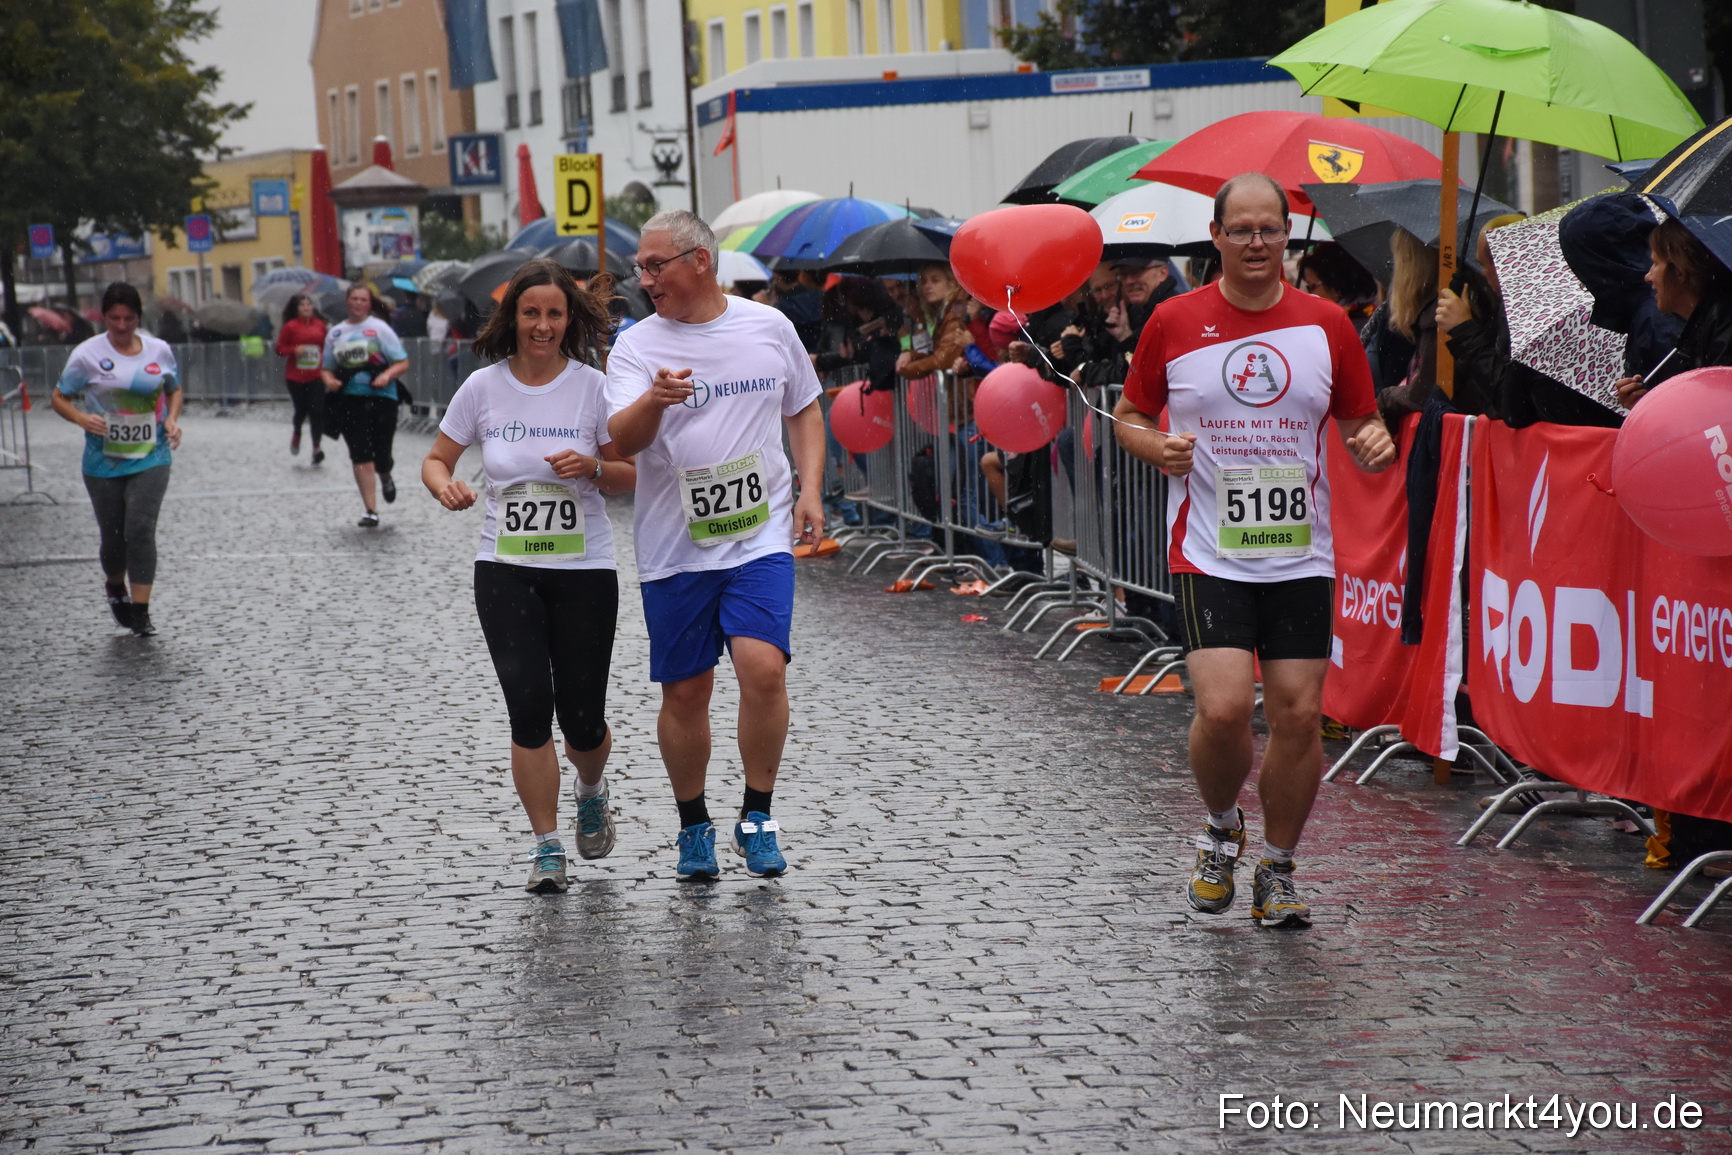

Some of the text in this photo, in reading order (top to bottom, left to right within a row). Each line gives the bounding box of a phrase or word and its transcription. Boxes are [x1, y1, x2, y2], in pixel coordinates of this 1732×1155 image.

[559, 158, 597, 172] Block
[567, 179, 591, 217] D
[1123, 218, 1150, 226] DKV
[714, 377, 777, 398] NEUMARKT
[109, 424, 152, 441] 5320
[529, 427, 580, 440] NEUMARKT
[1211, 434, 1223, 443] Dr.
[1225, 434, 1247, 443] Heck
[1255, 435, 1269, 443] Dr.
[1270, 435, 1299, 444] Röschl
[1211, 446, 1298, 457] Leistungsdiagnostik
[716, 454, 756, 476] BOCK
[1703, 424, 1732, 503] RO
[685, 474, 713, 482] NeuerMarkt
[1259, 468, 1304, 479] BOCK
[690, 472, 762, 517] 5278
[1227, 487, 1307, 523] 5198
[505, 500, 577, 532] 5279
[708, 514, 758, 534] Christian
[1241, 531, 1292, 545] Andreas
[525, 540, 554, 552] Irene
